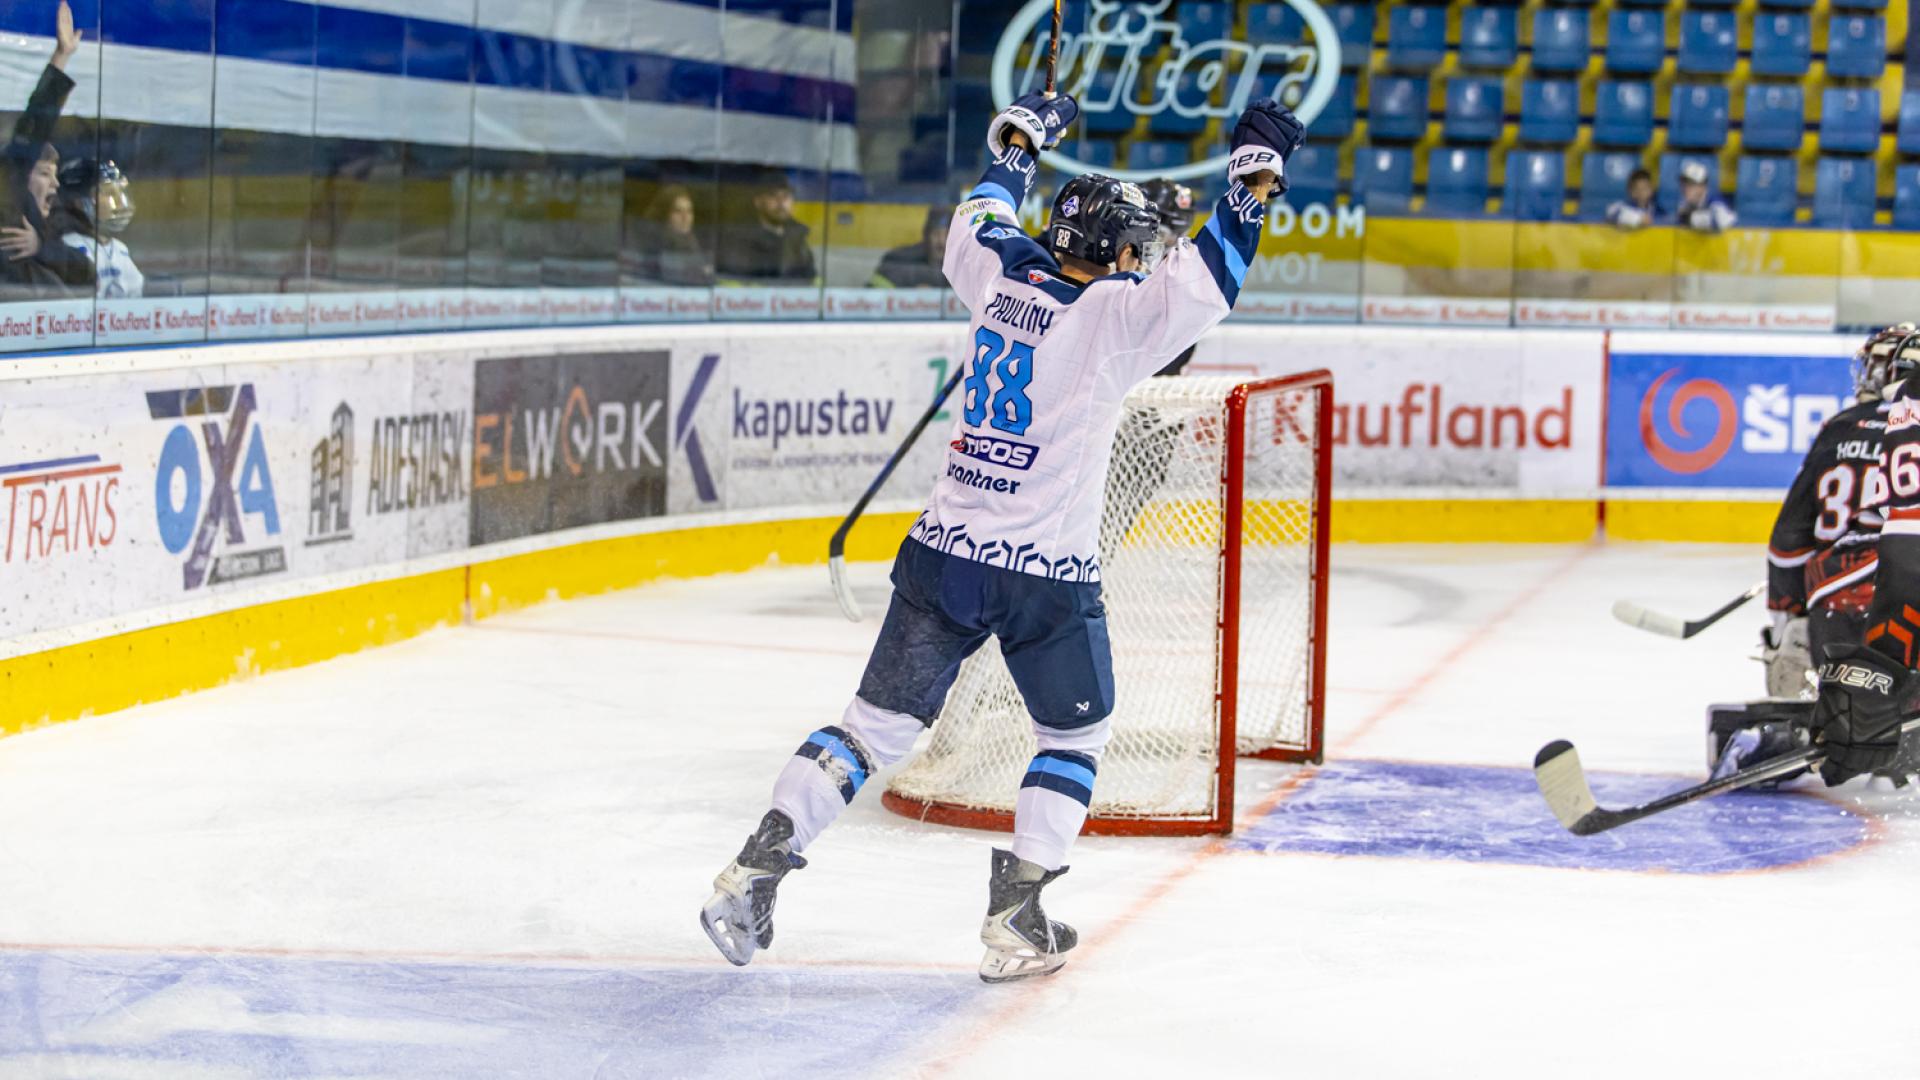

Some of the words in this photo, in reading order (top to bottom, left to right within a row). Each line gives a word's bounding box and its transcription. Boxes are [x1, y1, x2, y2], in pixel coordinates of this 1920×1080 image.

[1056, 228, 1071, 249] 88
[1269, 204, 1366, 239] DOM
[985, 293, 1055, 336] PAULÍNY
[964, 325, 1035, 436] 88
[732, 387, 894, 449] kapustav
[1742, 384, 1858, 453] ŠP
[1837, 440, 1883, 459] HOLL
[947, 460, 1021, 495] rantner
[3, 464, 122, 563] TRANS
[1818, 664, 1893, 695] UER
